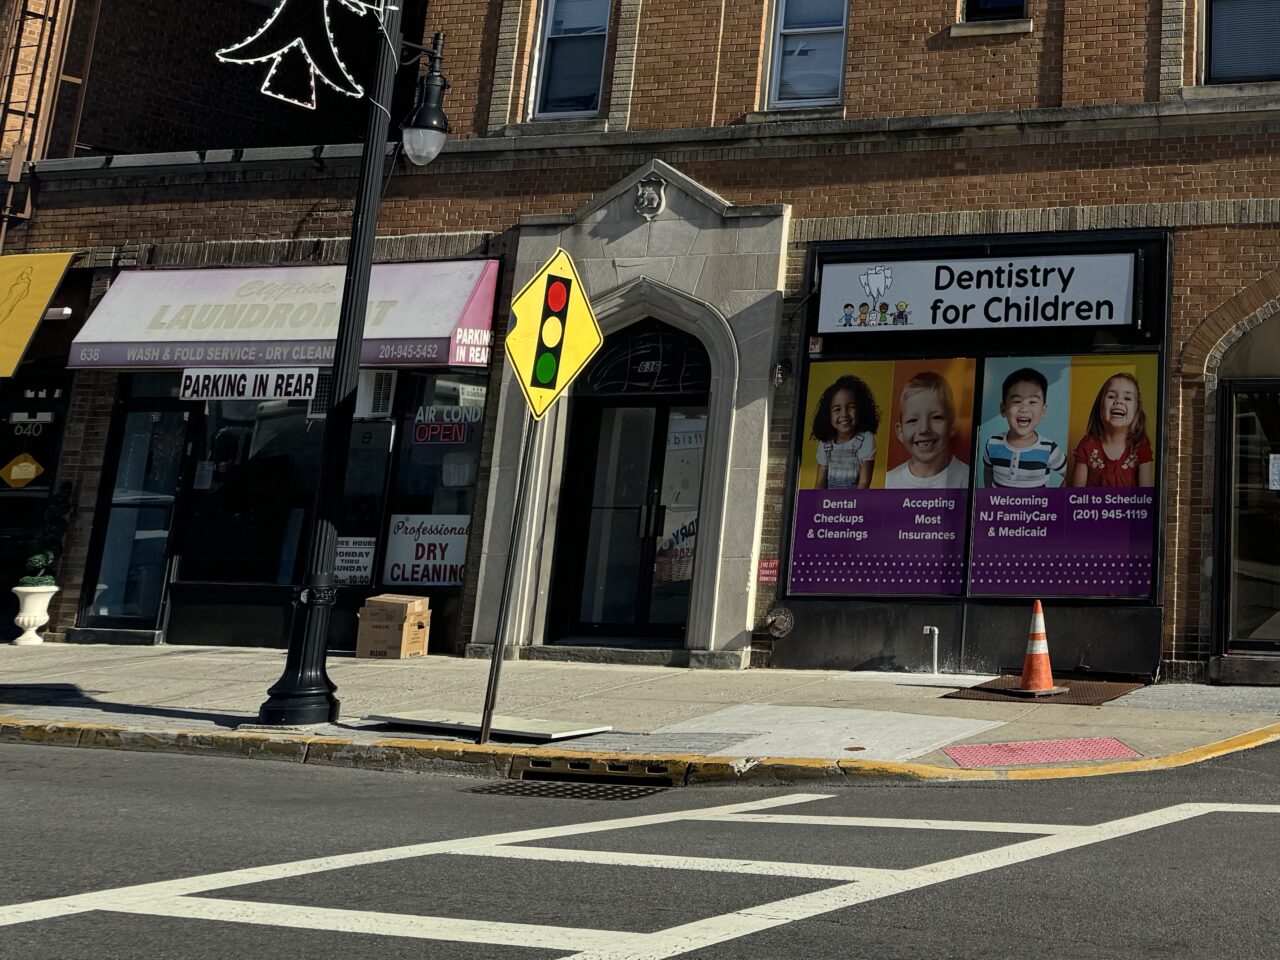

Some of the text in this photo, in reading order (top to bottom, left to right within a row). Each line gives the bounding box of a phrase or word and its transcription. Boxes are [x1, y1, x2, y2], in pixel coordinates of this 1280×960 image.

[934, 262, 1075, 294] Dentistry
[146, 300, 399, 331] LAUNDROMT
[930, 294, 1114, 325] for Children
[455, 327, 495, 346] PARKING
[80, 348, 100, 361] 638
[127, 347, 159, 361] WASH
[162, 347, 171, 361] &
[174, 347, 204, 361] FOLD
[206, 346, 256, 361] SERVICE
[265, 346, 288, 360] DRY
[291, 344, 335, 360] CLEANI
[378, 344, 438, 360] 201-945-5452
[455, 345, 492, 364] IN REAR
[182, 372, 313, 398] PARKING IN REAR
[414, 406, 437, 423] AIR
[14, 422, 43, 437] 640
[415, 424, 464, 442] OPEN
[822, 498, 857, 509] Dental
[902, 497, 955, 510] Accepting
[989, 494, 1049, 508] Welcoming
[1069, 494, 1153, 505] Call to Schedule
[813, 513, 864, 526] Checkups
[914, 514, 942, 525] Most
[979, 510, 1058, 524] NJ FamilyCare
[1072, 509, 1148, 521] (201) 945-1119
[393, 520, 471, 541] Professional
[806, 528, 868, 541] & Cleanings
[898, 529, 956, 540] Insurances
[987, 526, 1047, 537] & Medicaid
[414, 542, 449, 561] DRY
